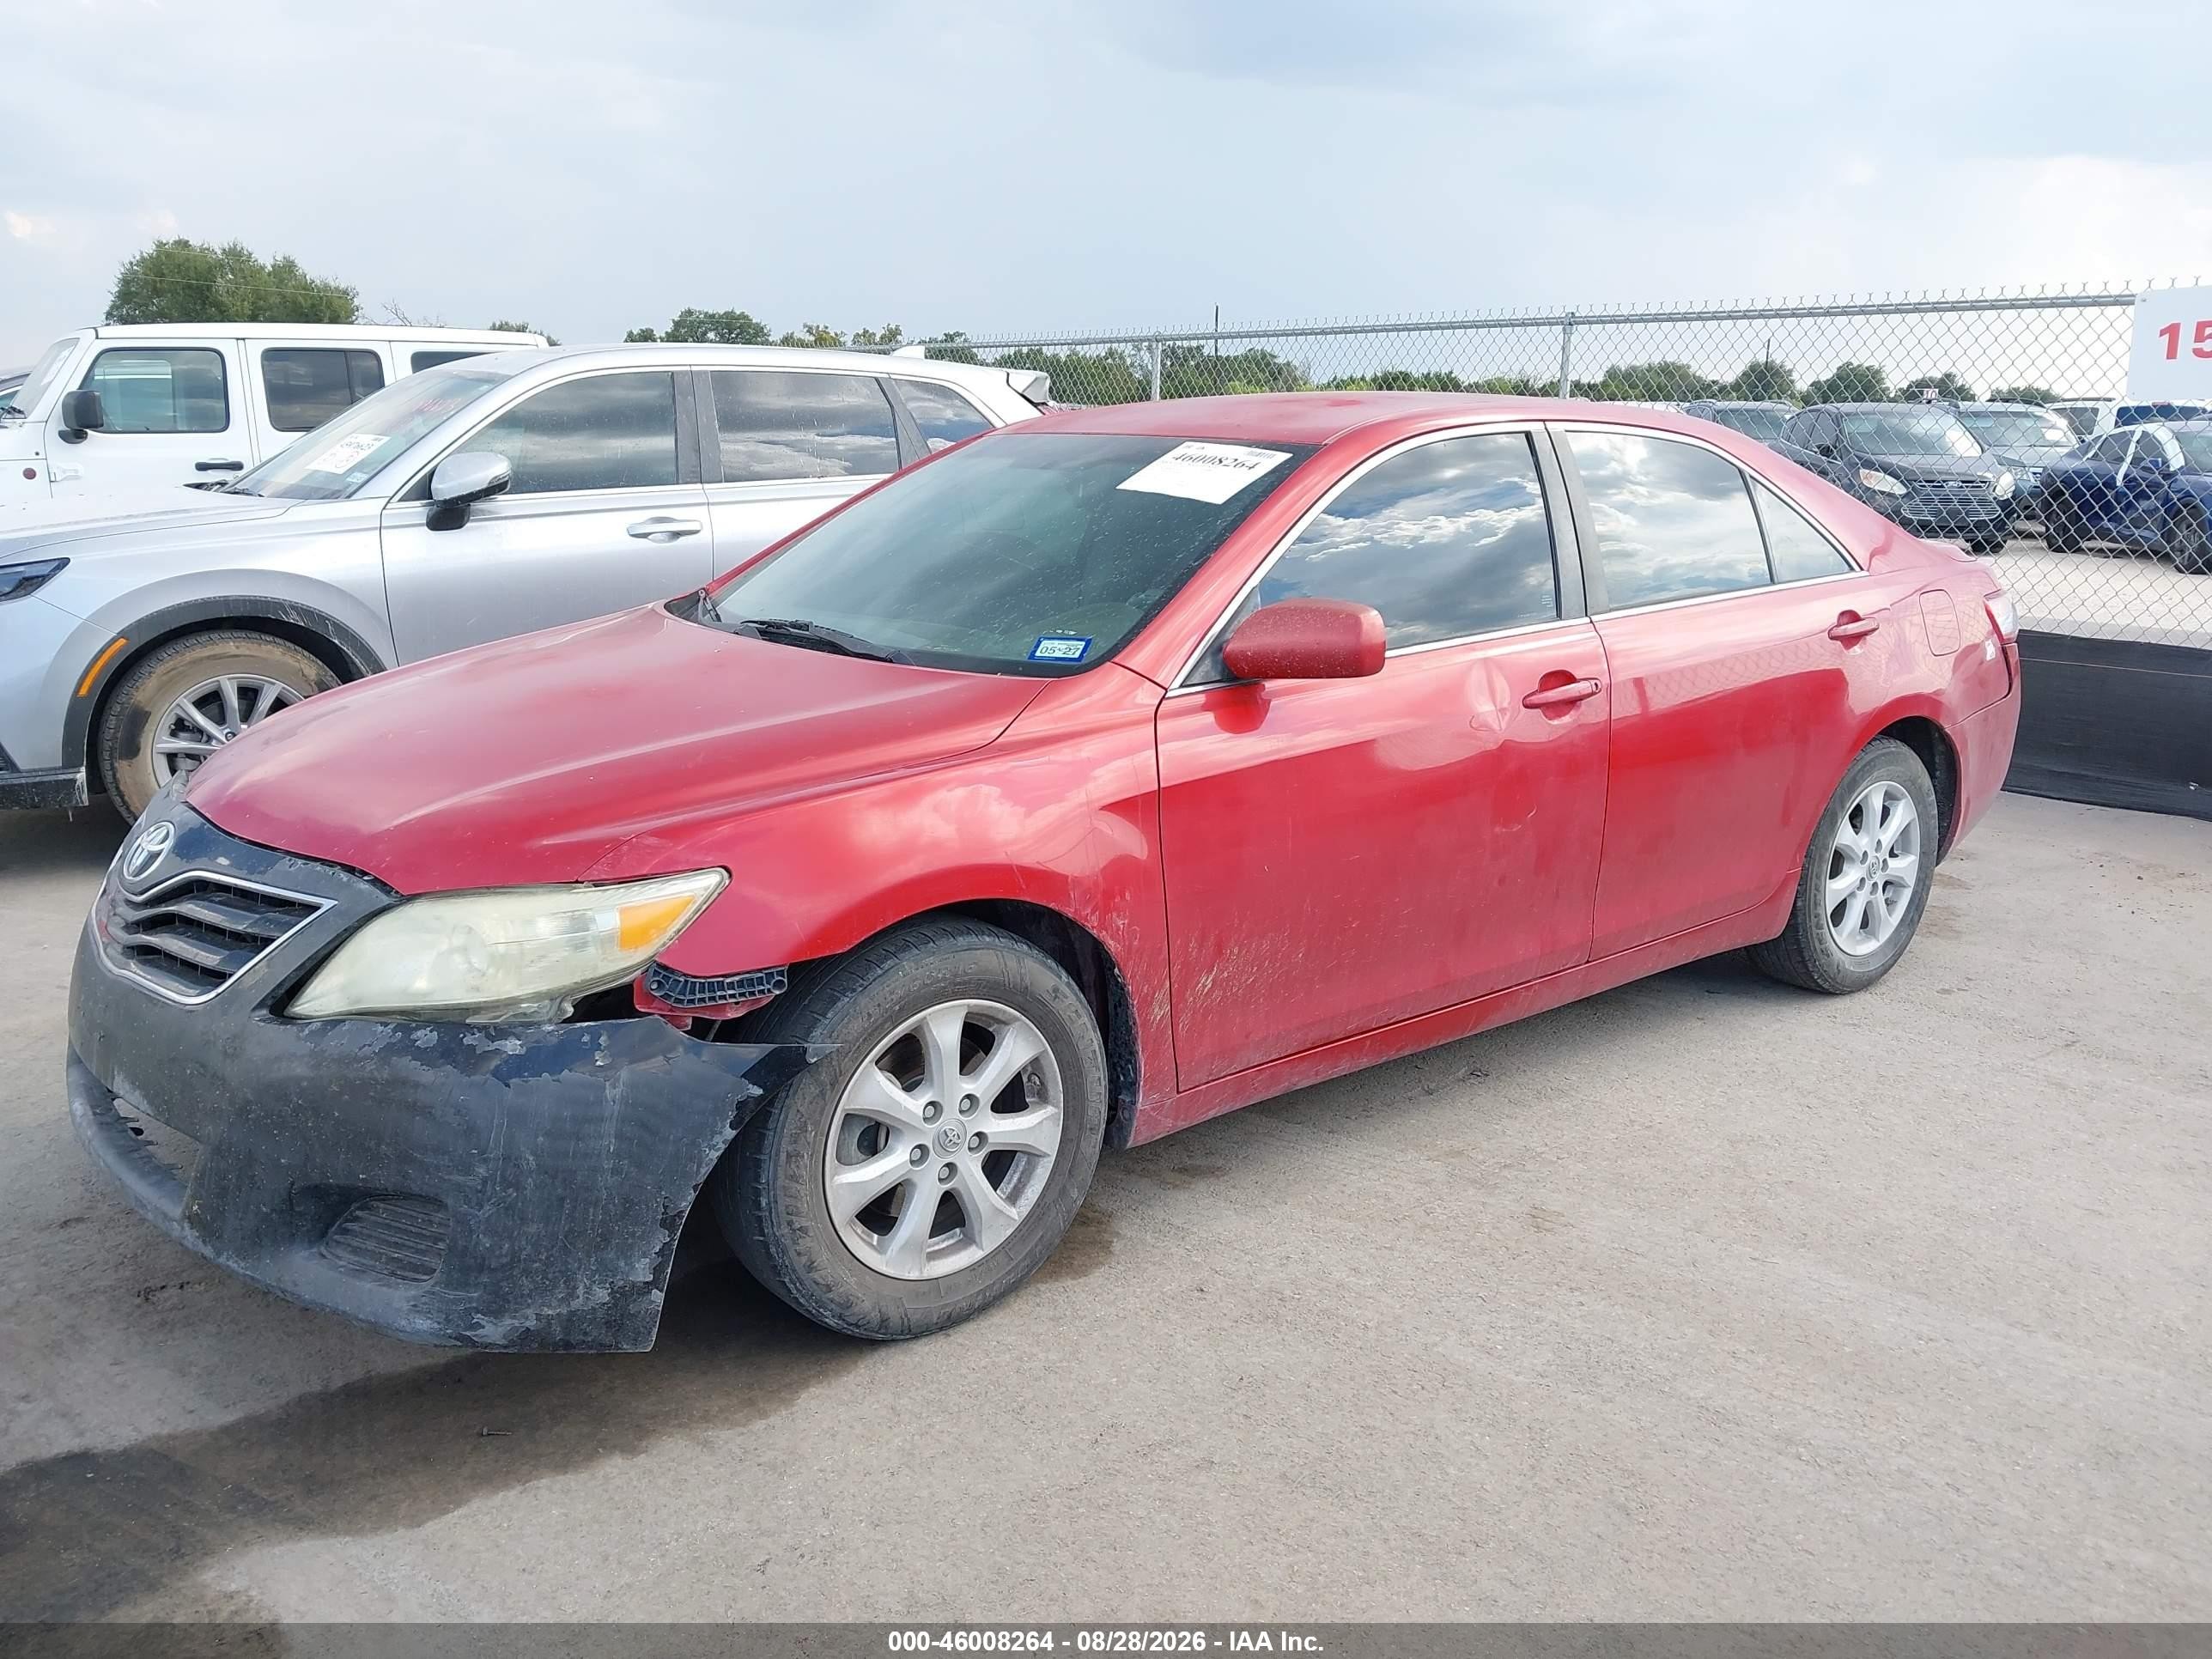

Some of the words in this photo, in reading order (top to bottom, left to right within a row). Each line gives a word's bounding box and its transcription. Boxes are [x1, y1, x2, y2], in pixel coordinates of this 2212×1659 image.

[1171, 452, 1261, 471] 46008264
[1039, 646, 1057, 655] 05
[1062, 646, 1081, 656] 27
